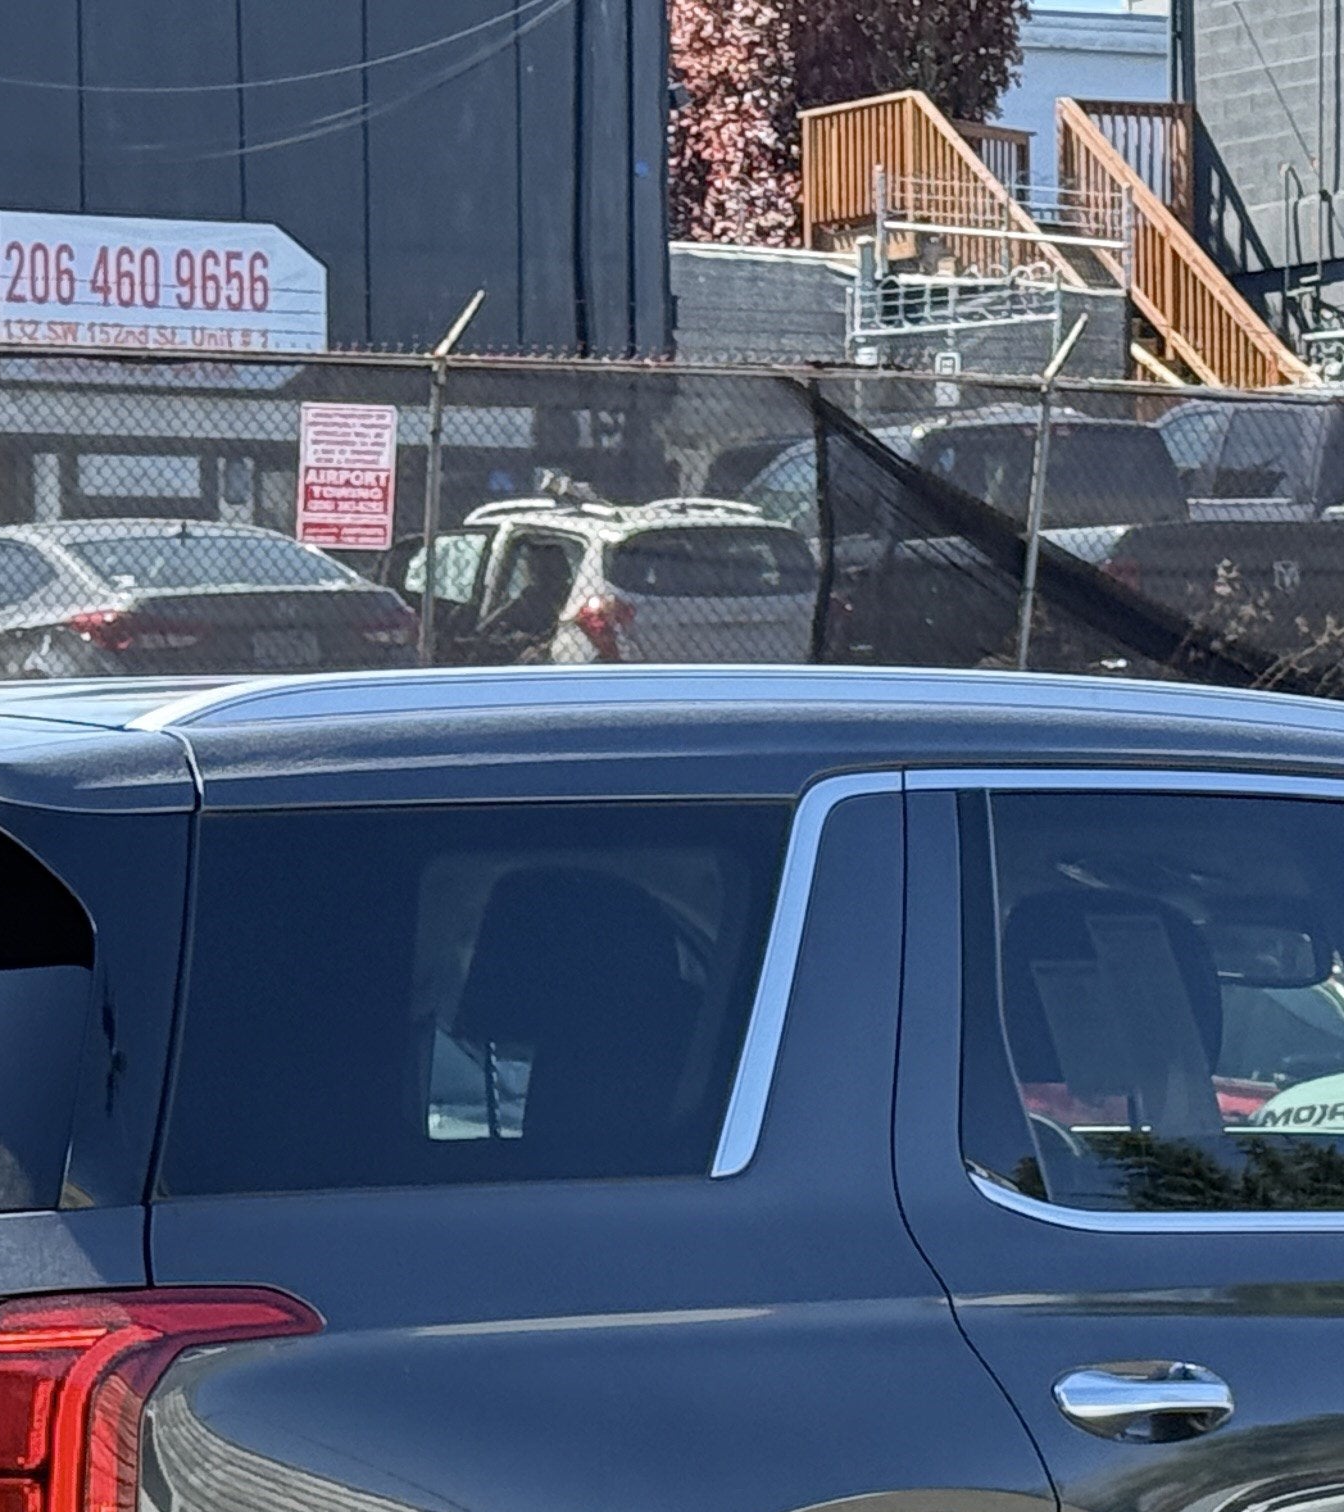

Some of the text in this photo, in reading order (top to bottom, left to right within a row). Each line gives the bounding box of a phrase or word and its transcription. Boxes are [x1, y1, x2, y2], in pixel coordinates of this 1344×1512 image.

[5, 240, 270, 313] 206 460 9656
[87, 321, 150, 346] 152nd
[191, 325, 233, 348] Unit
[305, 469, 390, 487] AIRPORT
